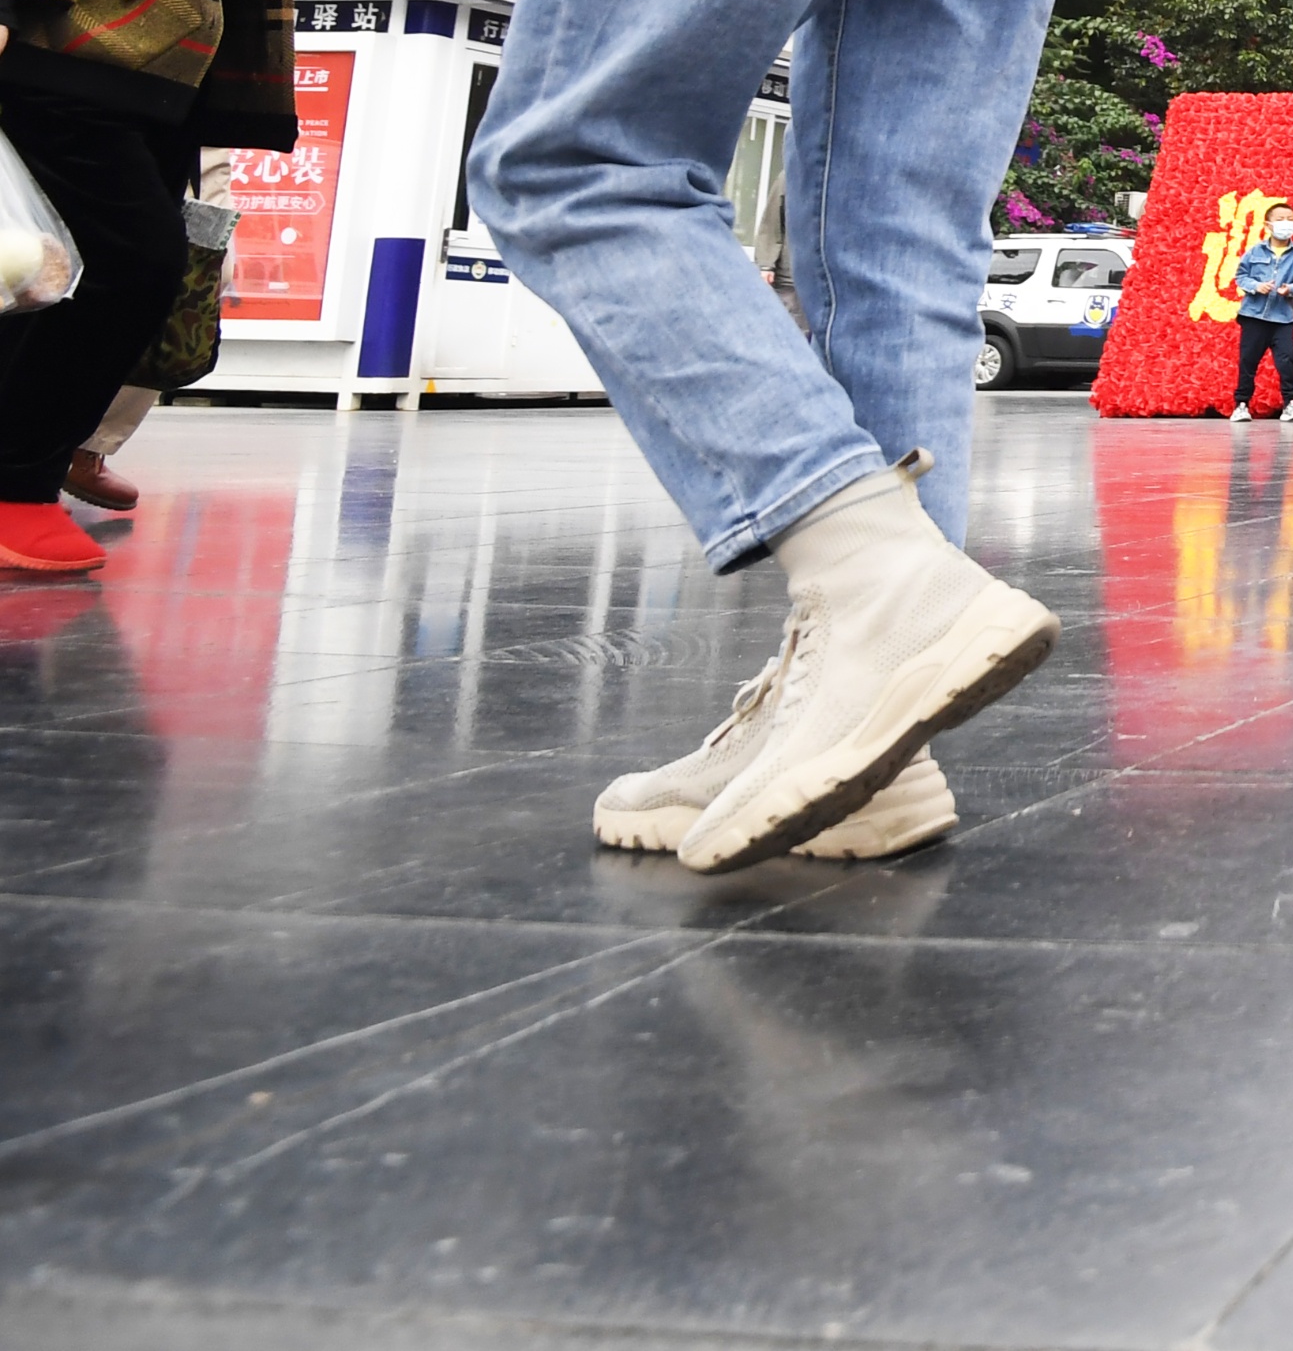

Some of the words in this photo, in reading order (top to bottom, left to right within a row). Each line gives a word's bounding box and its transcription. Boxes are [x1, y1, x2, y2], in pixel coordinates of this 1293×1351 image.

[294, 3, 380, 31] 驿站
[229, 148, 328, 185] 安心装
